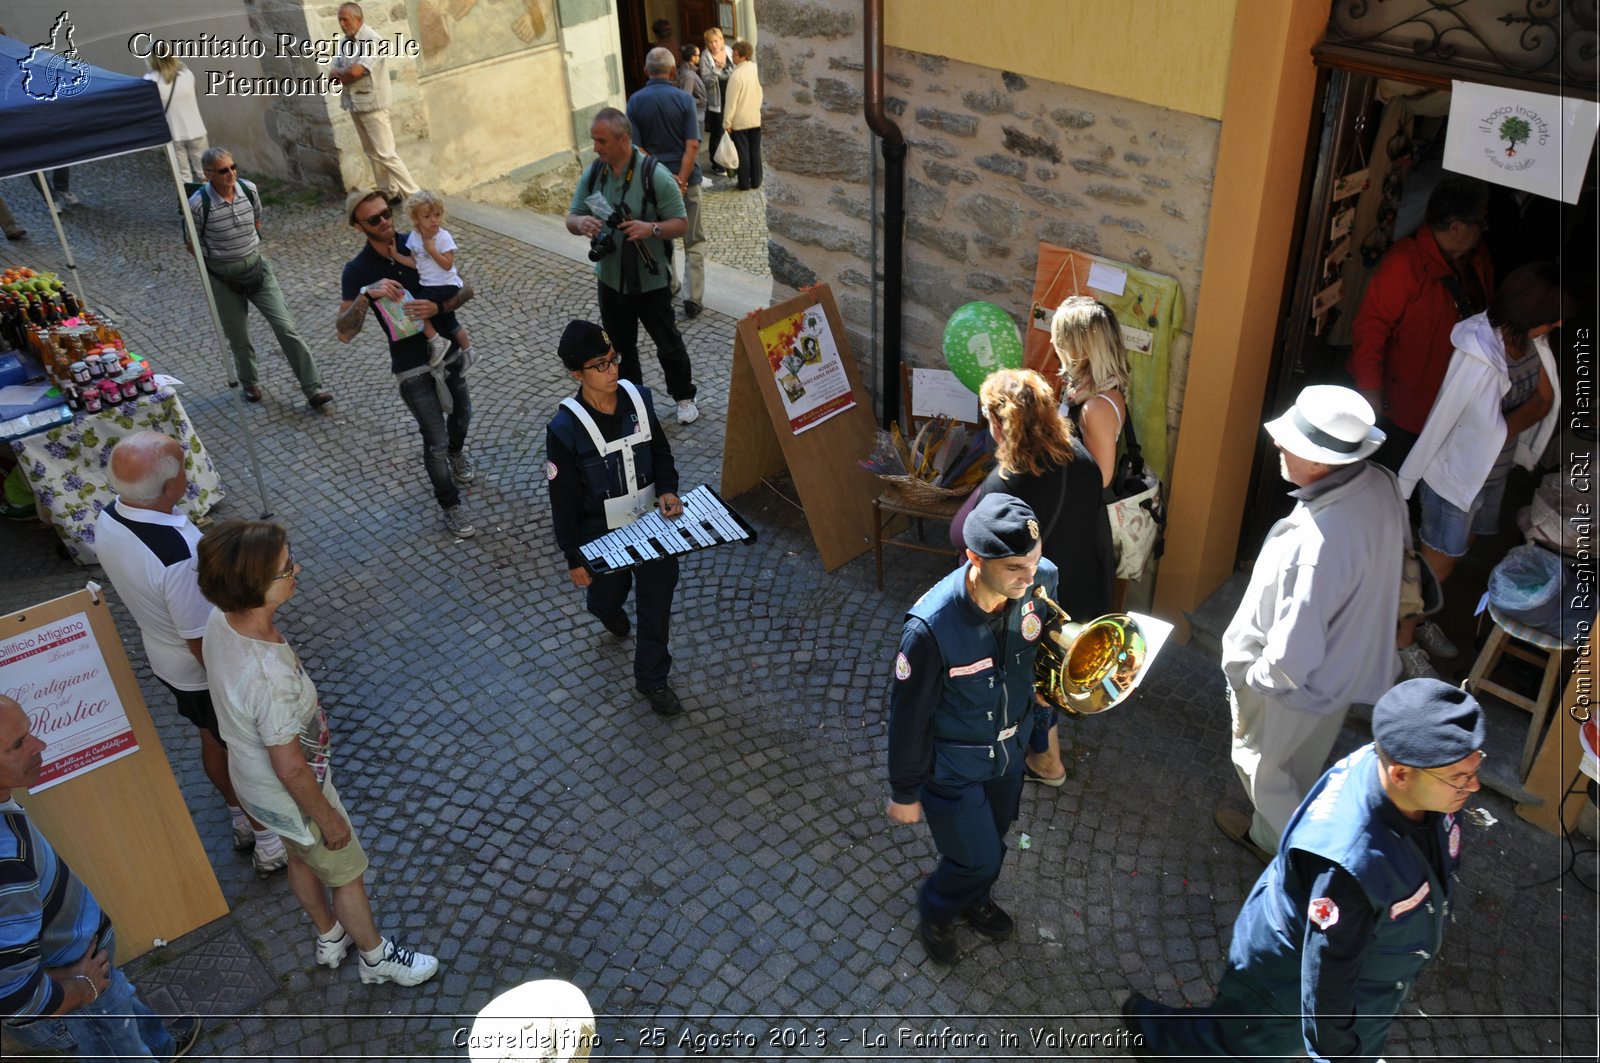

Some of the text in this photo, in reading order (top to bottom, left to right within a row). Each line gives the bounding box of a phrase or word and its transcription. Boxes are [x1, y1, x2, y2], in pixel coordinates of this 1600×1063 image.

[1481, 105, 1513, 125] bosco
[1515, 104, 1551, 146] incantato
[38, 621, 84, 642] Artigiano
[27, 699, 110, 738] Rustico
